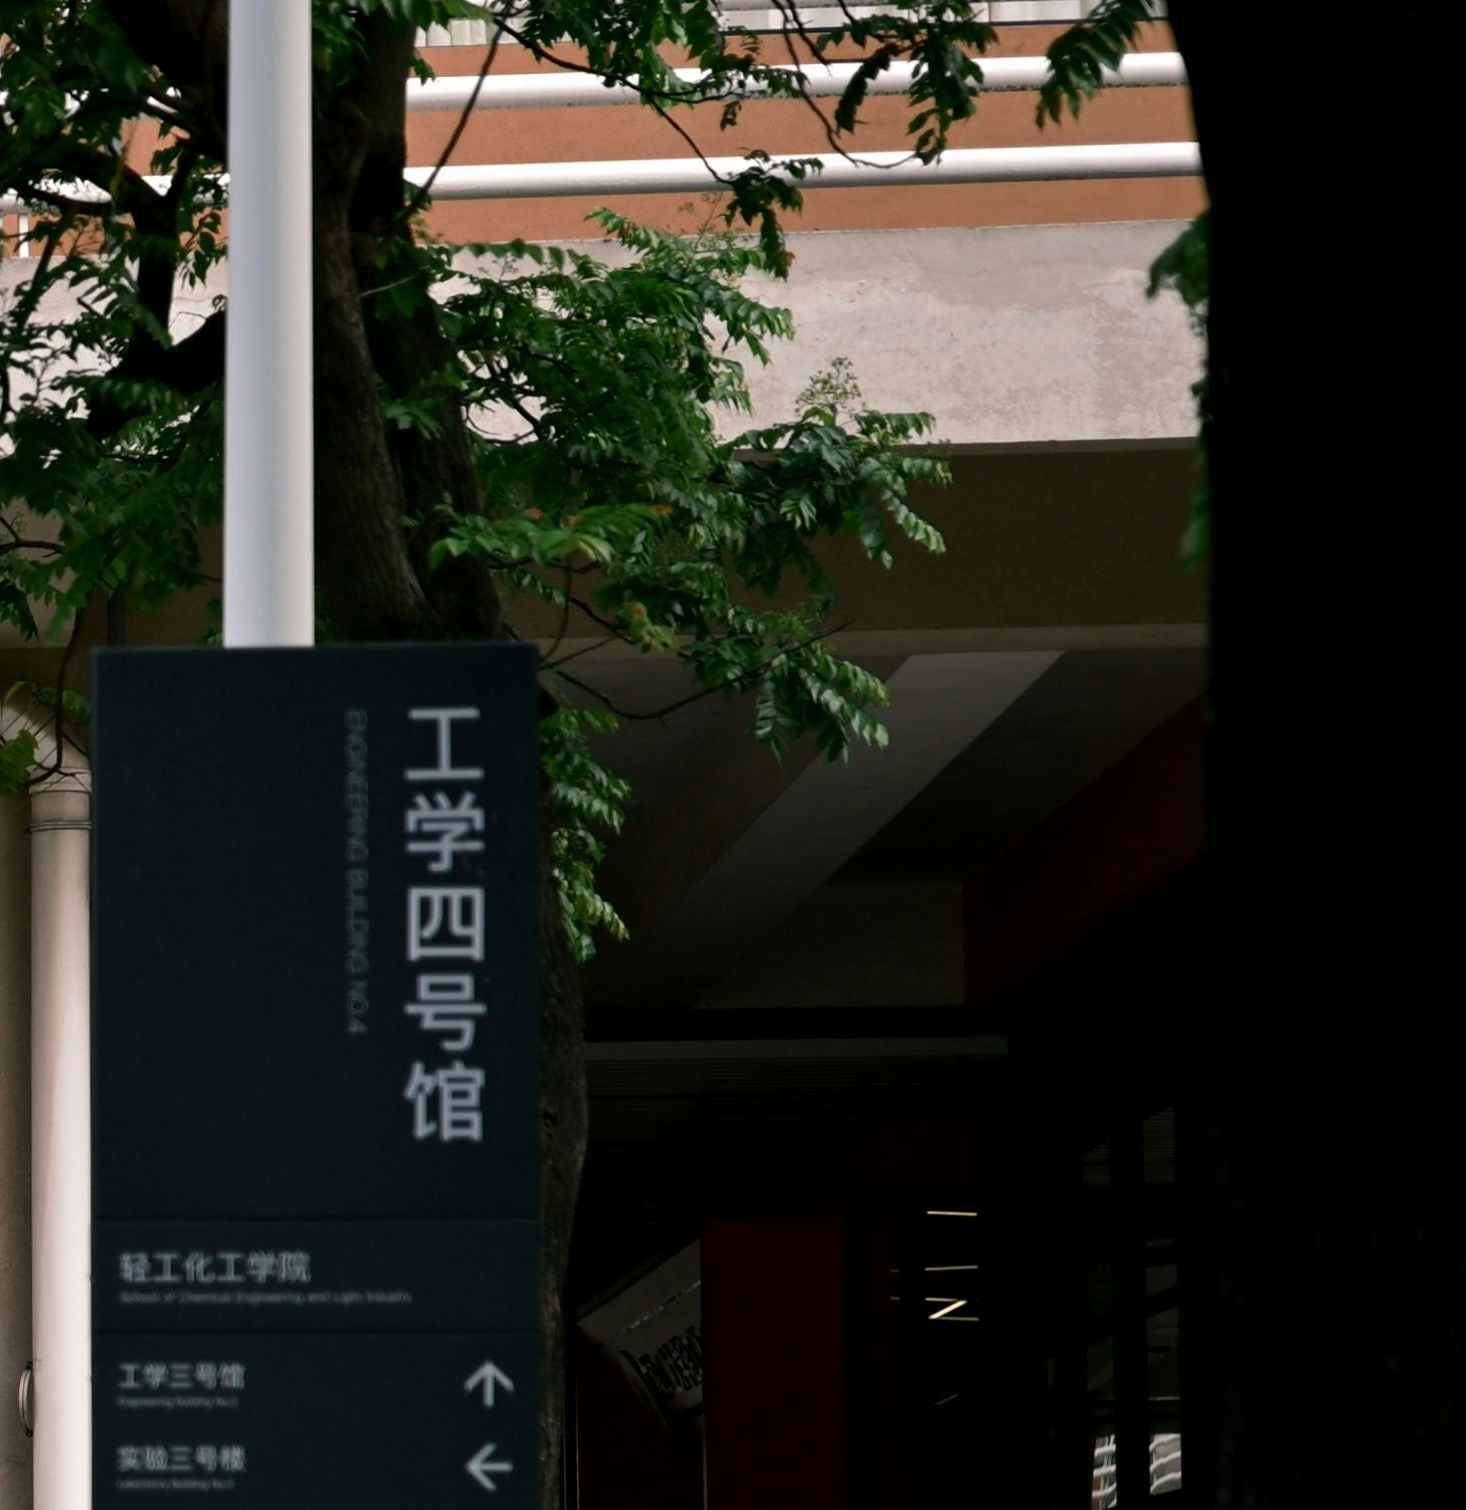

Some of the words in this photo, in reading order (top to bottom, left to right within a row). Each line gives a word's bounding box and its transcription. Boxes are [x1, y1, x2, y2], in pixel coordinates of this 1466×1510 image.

[345, 708, 369, 862] ENGINEERING
[345, 868, 369, 974] BUILDING
[403, 706, 487, 1143] 工学四号馆
[118, 1251, 311, 1284] 轻工化工学院
[117, 1362, 245, 1390] 工学三号馆
[116, 1445, 246, 1472] 实验三号楼
